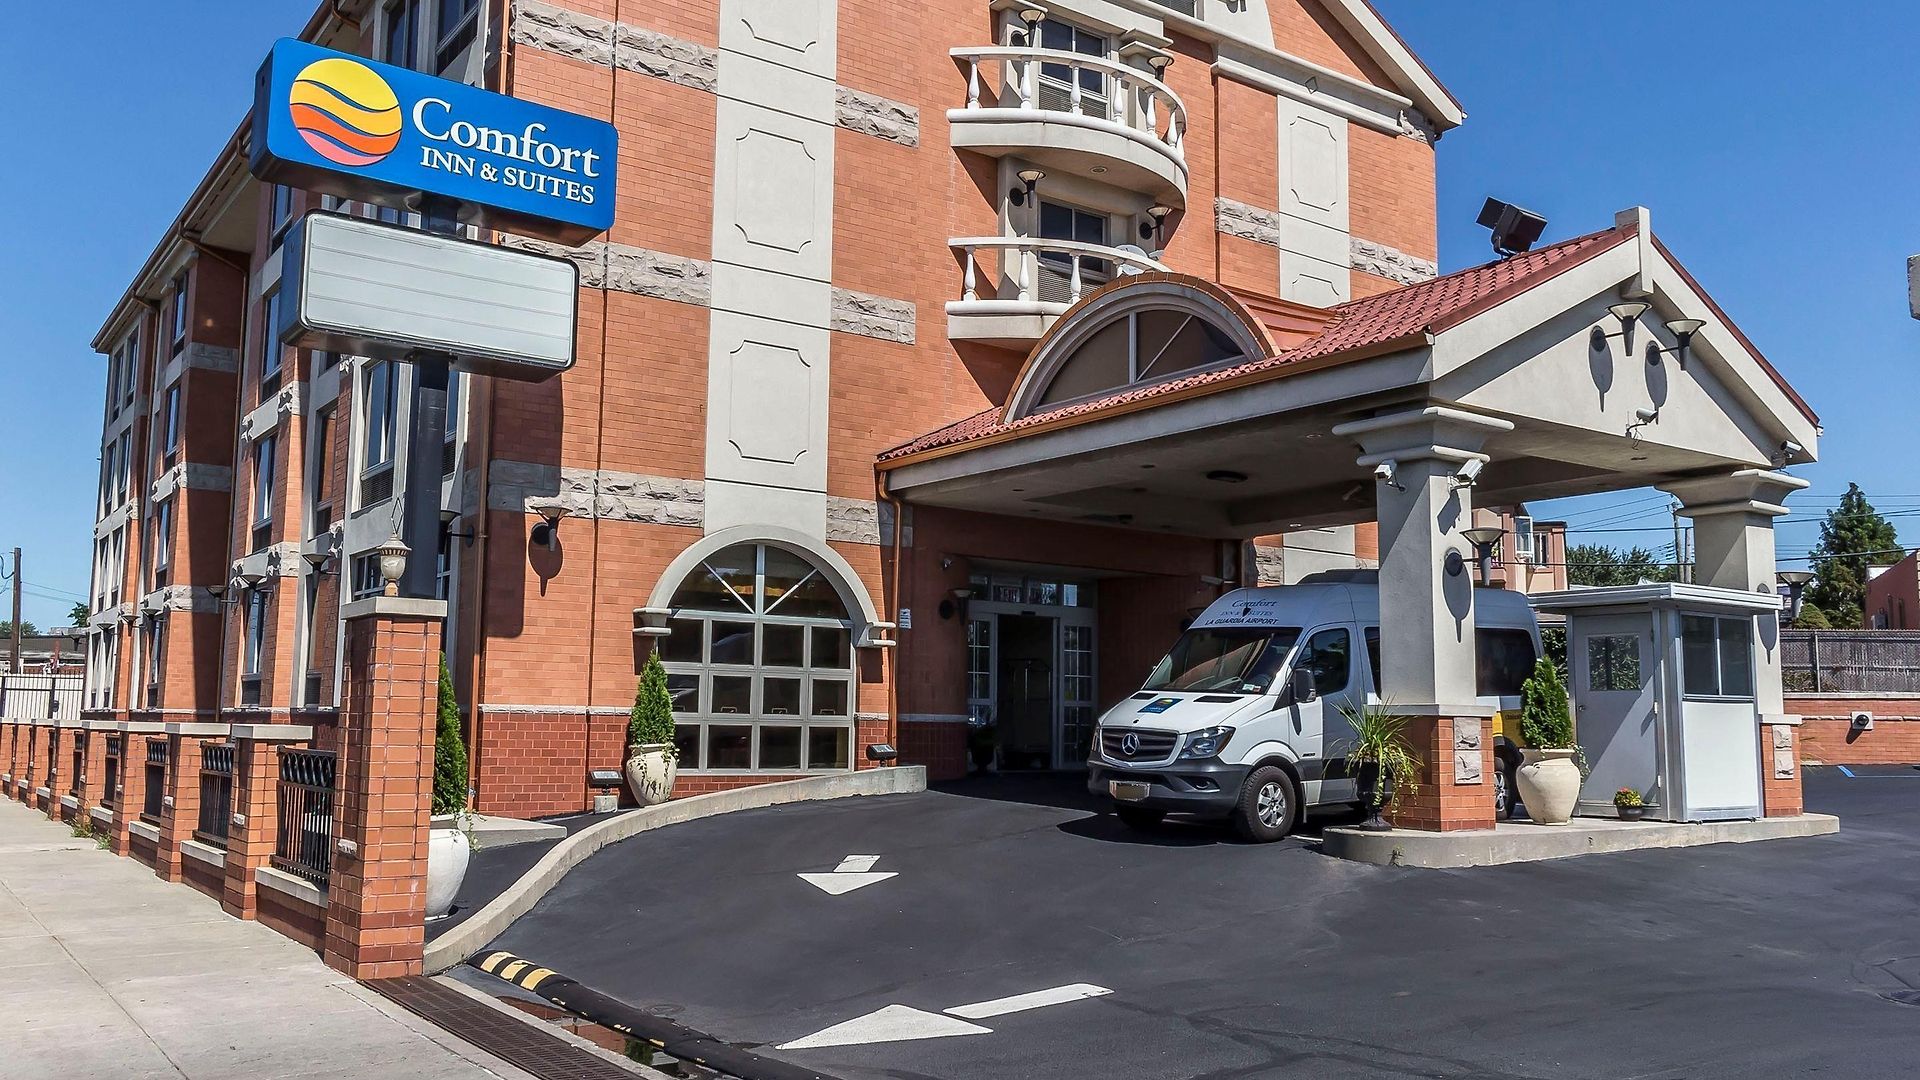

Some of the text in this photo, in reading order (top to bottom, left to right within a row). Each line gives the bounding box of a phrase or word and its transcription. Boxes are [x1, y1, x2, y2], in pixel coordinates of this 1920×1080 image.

[412, 97, 600, 177] Comfort
[420, 146, 595, 204] INN & SUITES
[1232, 599, 1278, 608] Comfort
[1214, 617, 1244, 625] GUARDIA
[1245, 617, 1280, 625] AIRPORT
